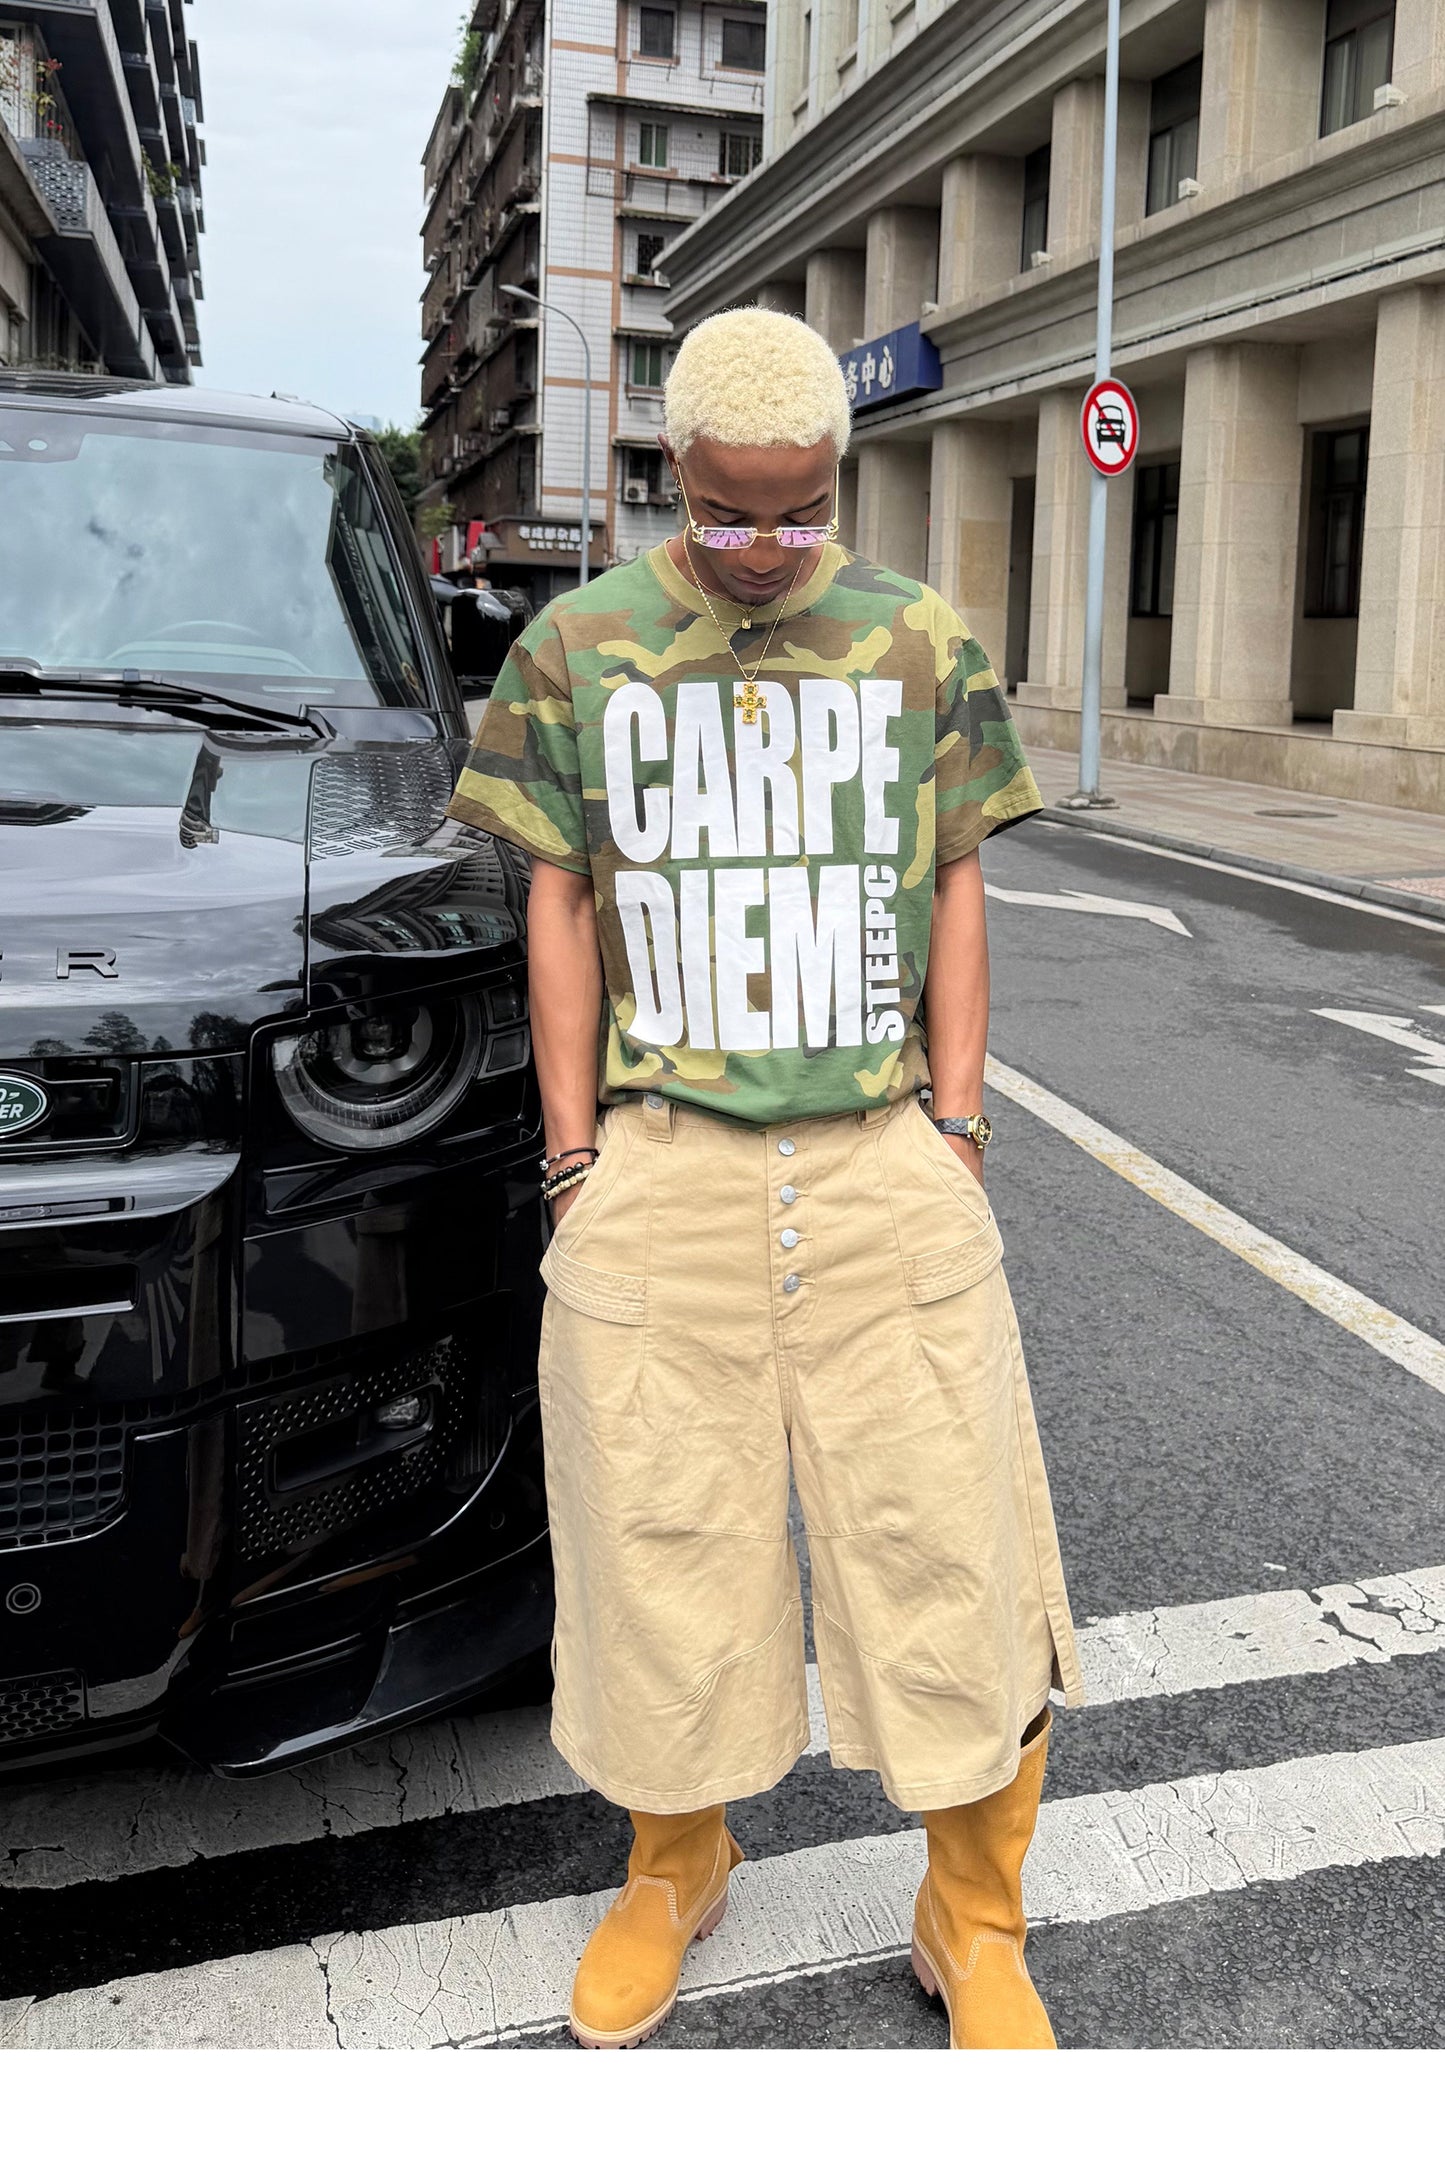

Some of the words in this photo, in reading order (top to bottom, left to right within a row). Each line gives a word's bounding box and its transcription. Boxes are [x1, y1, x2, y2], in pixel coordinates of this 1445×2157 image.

[603, 679, 903, 864] CARPE
[614, 864, 863, 1050] DIEM
[863, 864, 906, 1045] STEEPC
